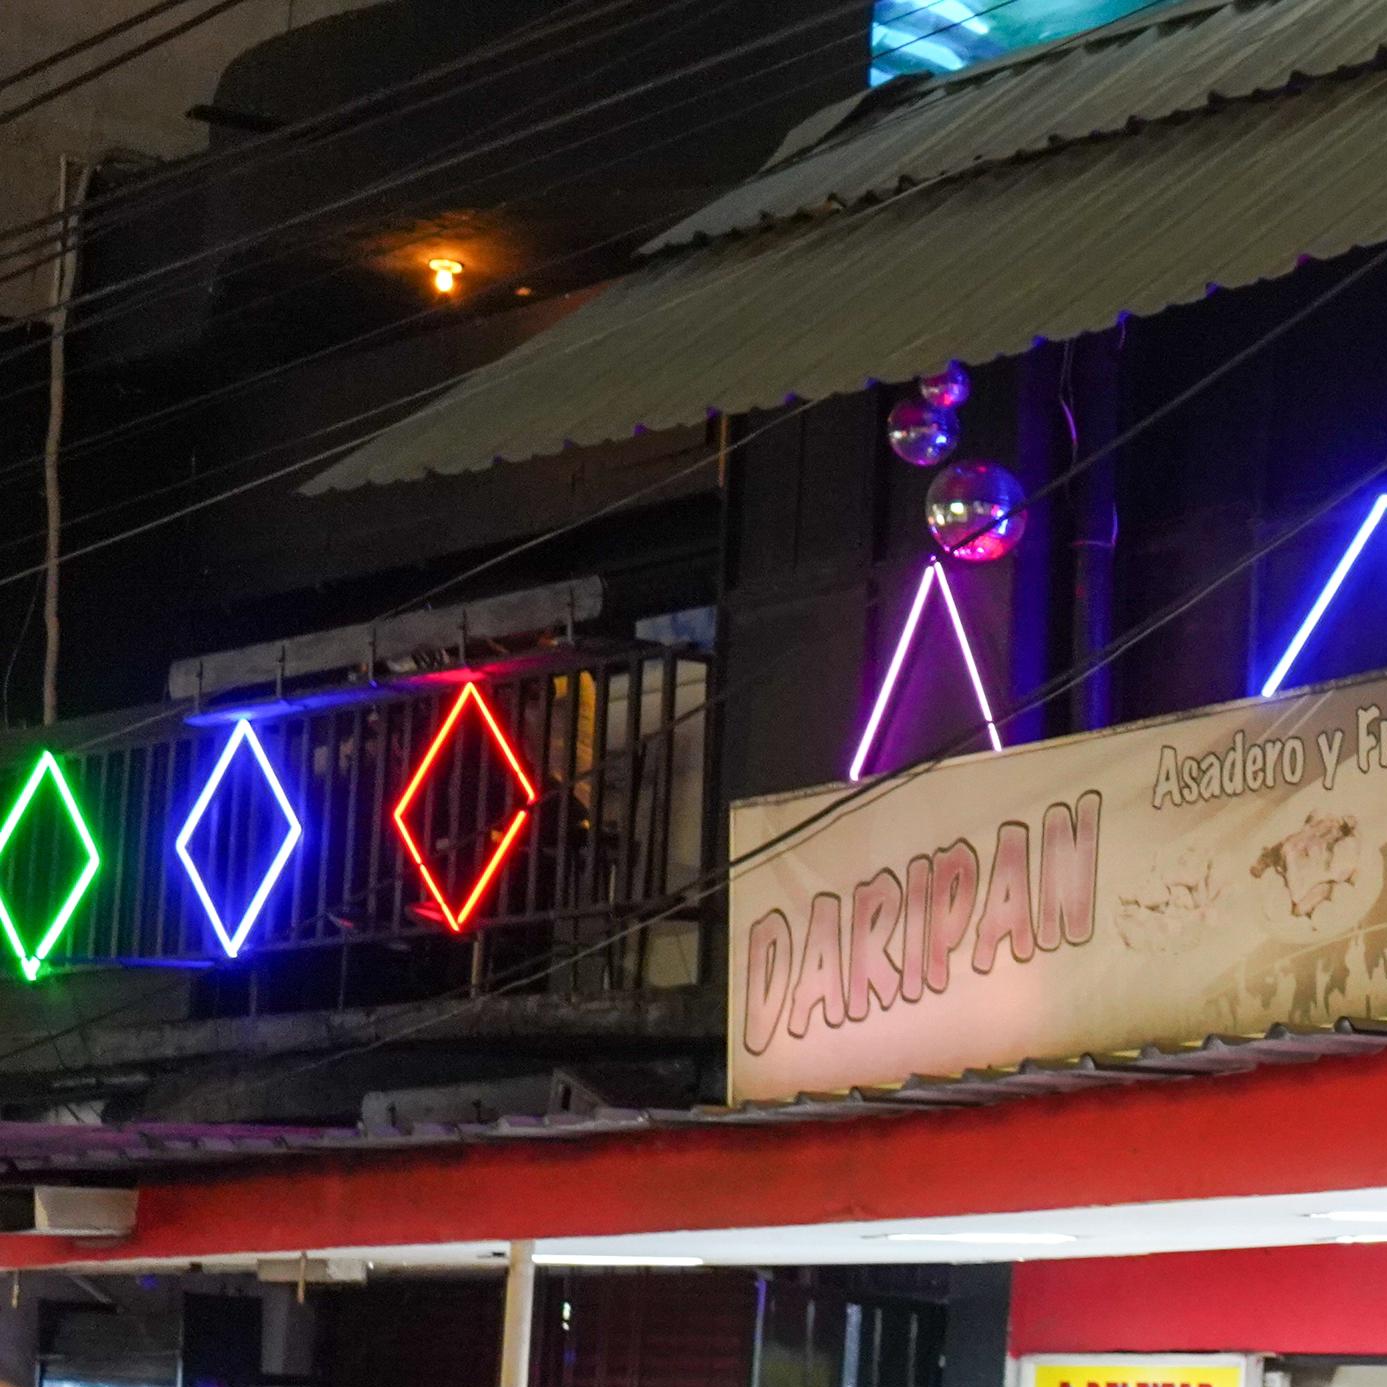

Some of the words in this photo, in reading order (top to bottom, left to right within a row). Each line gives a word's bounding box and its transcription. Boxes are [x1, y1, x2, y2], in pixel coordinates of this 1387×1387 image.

[1152, 728, 1304, 809] Asadero
[1323, 726, 1342, 790] y
[743, 790, 1104, 1055] DARIPAN
